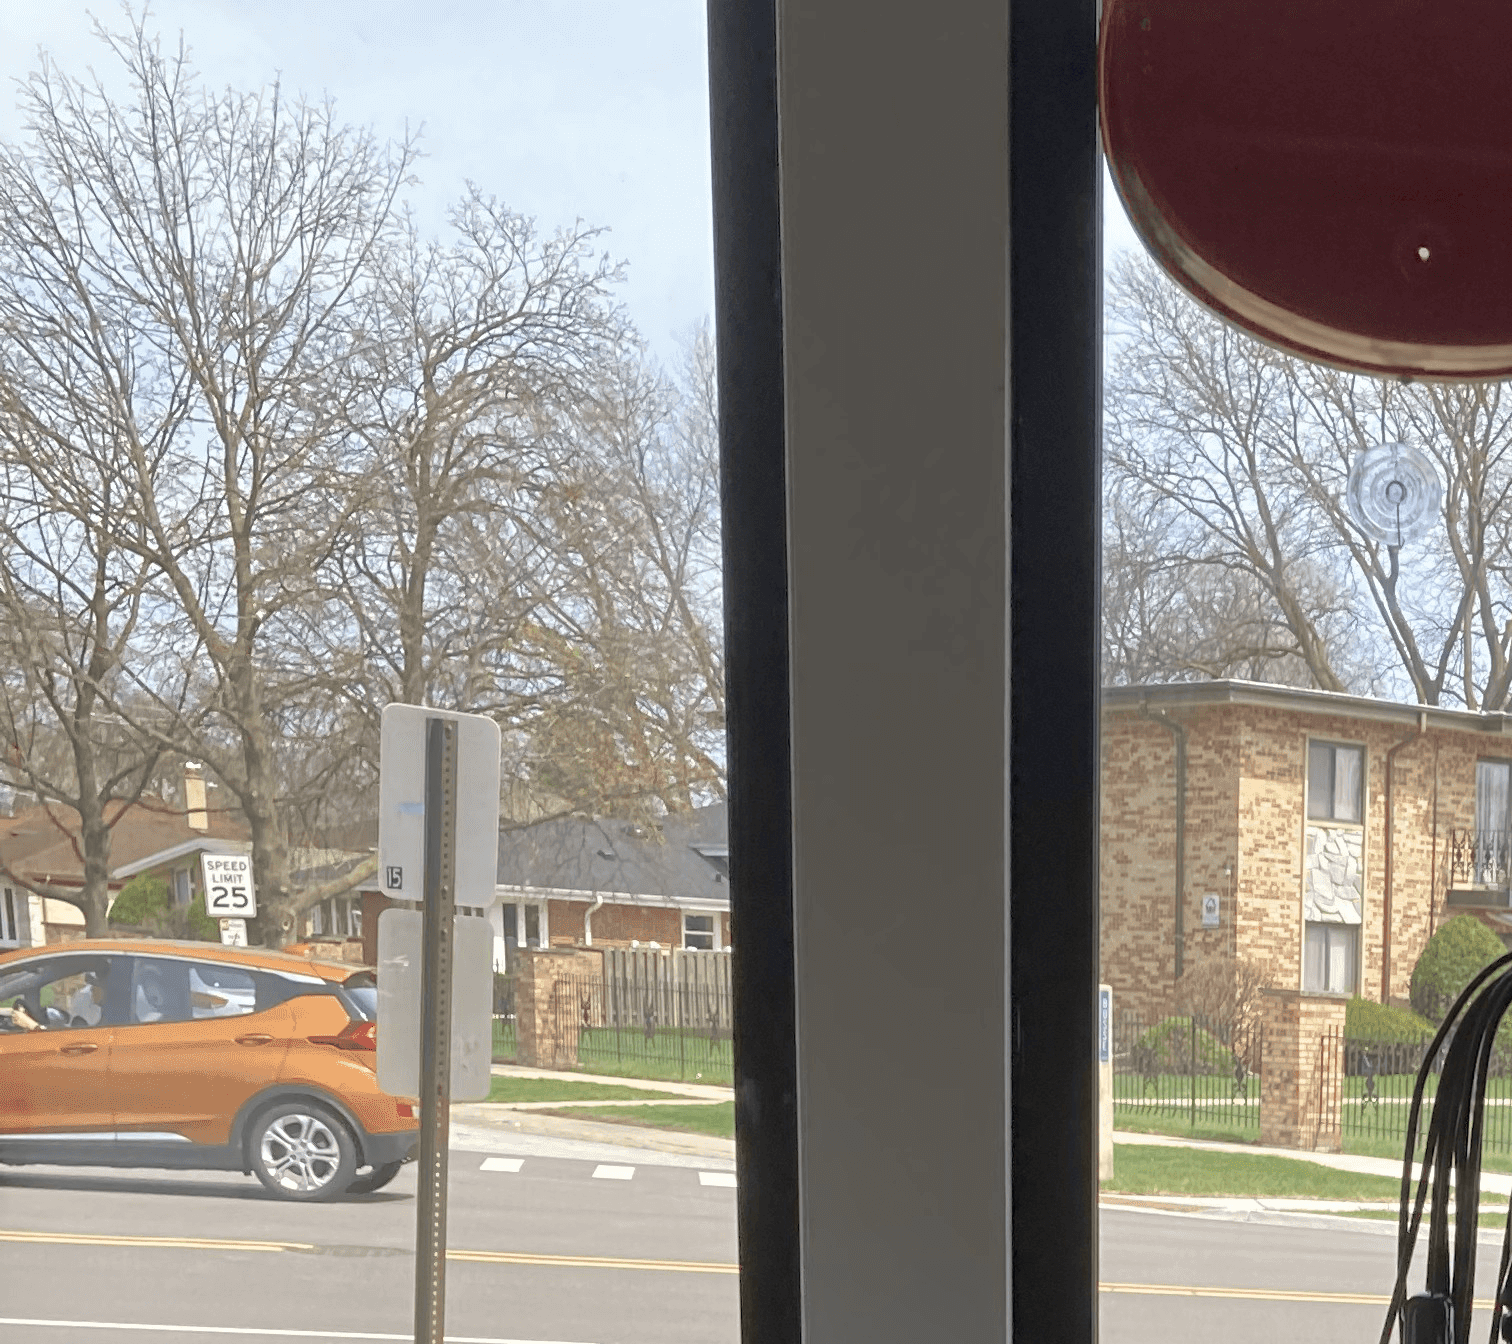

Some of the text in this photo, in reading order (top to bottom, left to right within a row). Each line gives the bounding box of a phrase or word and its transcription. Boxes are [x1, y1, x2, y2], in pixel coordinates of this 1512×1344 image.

[206, 860, 247, 871] SPEED
[212, 873, 243, 884] LIMIT
[387, 867, 401, 888] 15
[212, 886, 249, 908] 25
